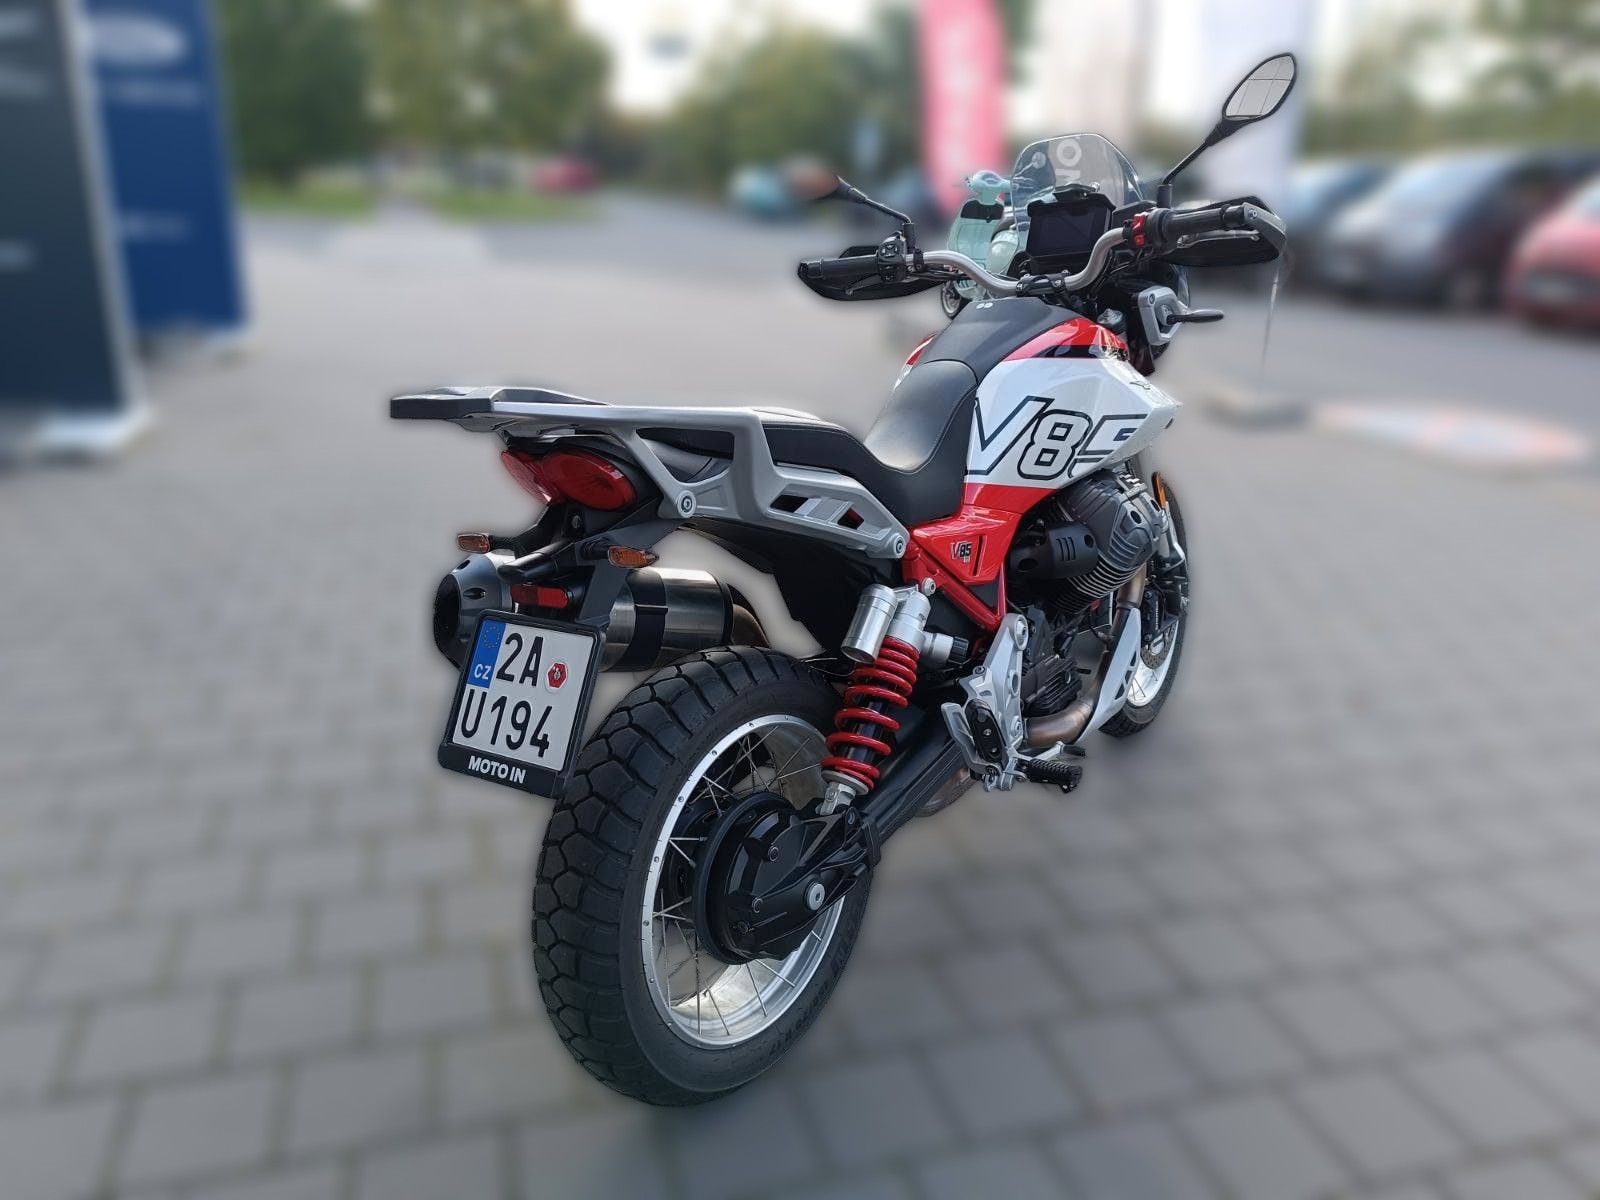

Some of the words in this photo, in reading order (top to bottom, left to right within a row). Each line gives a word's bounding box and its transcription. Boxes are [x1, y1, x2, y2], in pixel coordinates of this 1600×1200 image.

[950, 541, 972, 559] V85
[474, 663, 493, 680] CZ
[496, 632, 544, 686] 2A
[461, 689, 553, 757] U194
[468, 755, 509, 779] MOTO
[509, 768, 526, 784] IN
